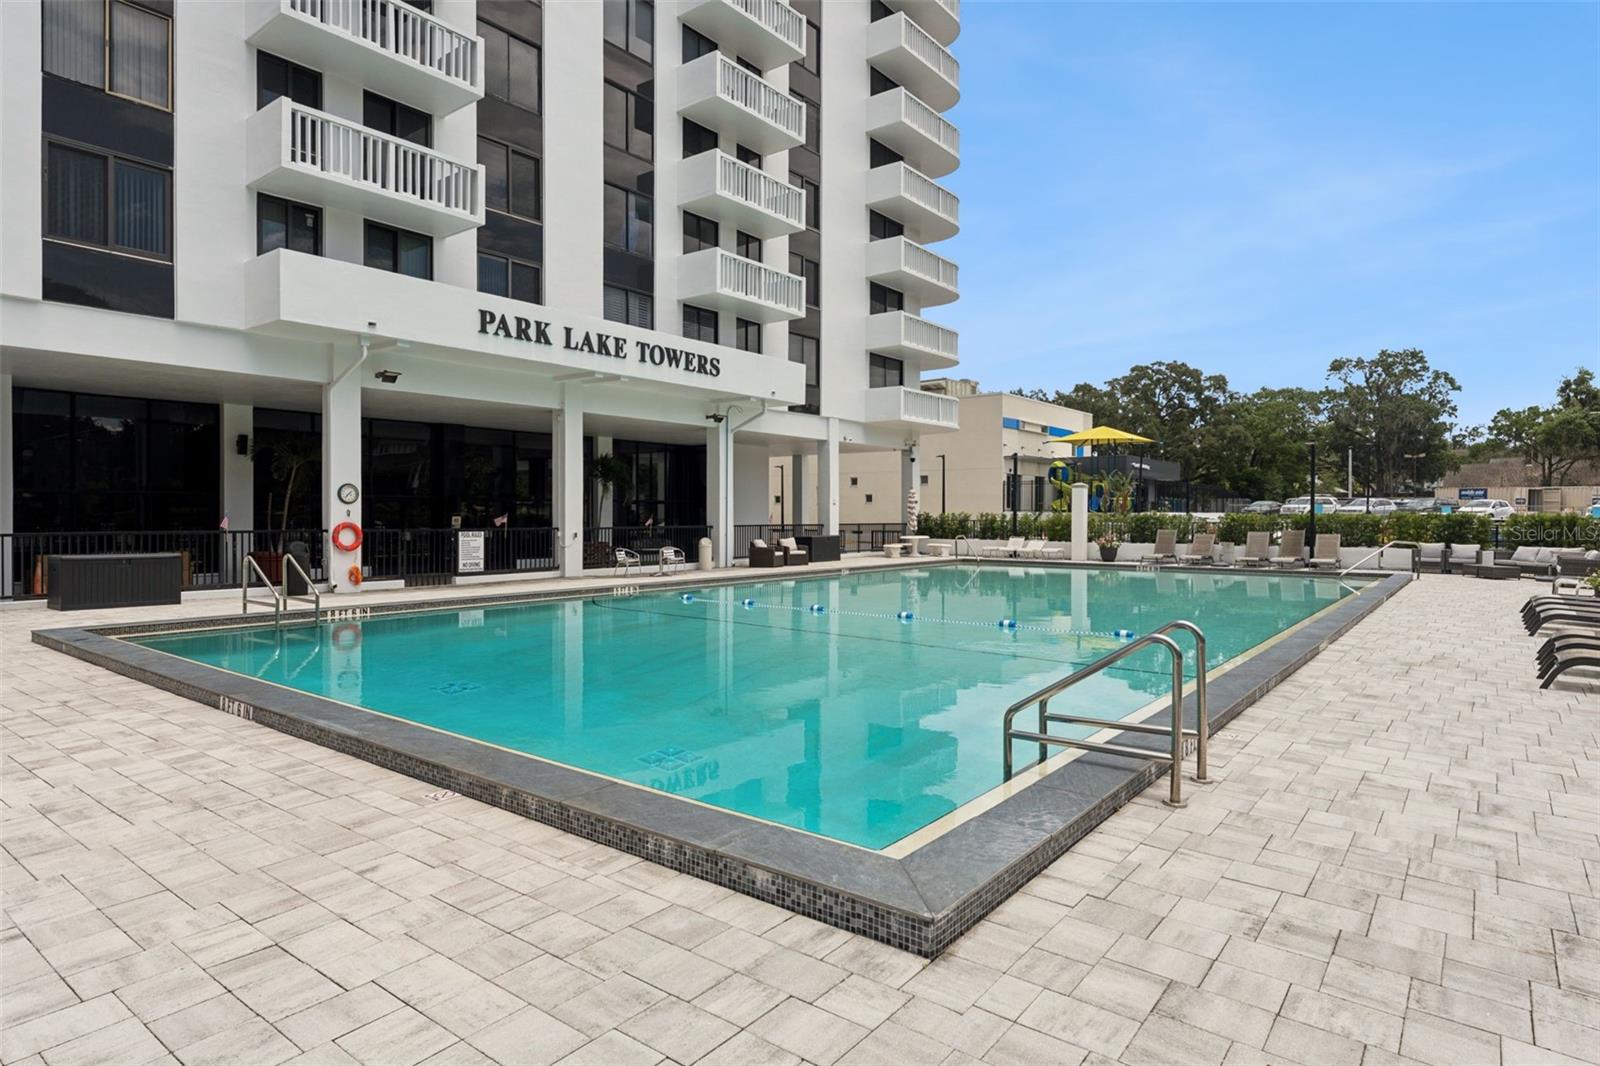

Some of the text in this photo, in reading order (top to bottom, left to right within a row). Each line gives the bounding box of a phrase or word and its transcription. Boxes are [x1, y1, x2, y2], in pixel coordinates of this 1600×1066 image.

[478, 309, 720, 377] PARK LAKE TOWERS
[339, 609, 348, 617] FT
[360, 607, 368, 615] IN
